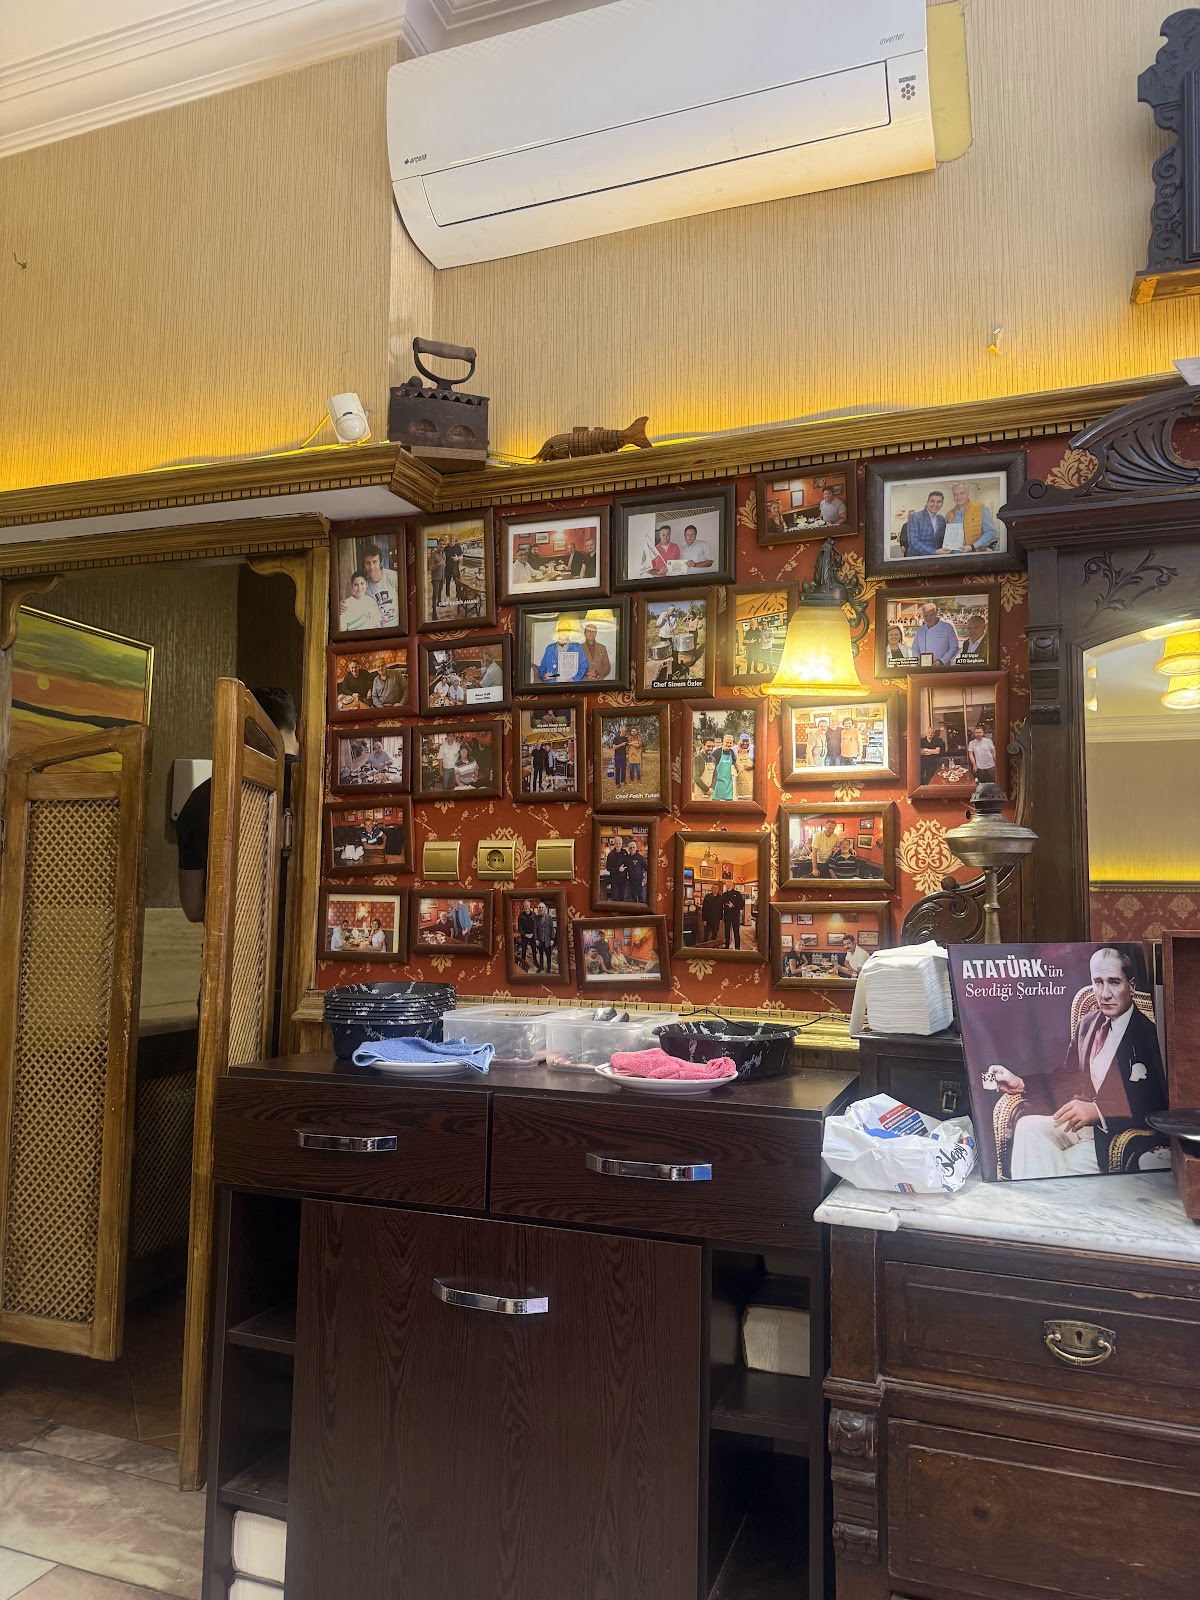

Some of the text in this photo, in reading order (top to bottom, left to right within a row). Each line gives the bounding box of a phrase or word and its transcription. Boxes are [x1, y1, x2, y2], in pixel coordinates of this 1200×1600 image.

[879, 32, 906, 46] inverter
[667, 680, 687, 688] Sinem
[687, 679, 703, 687] Özler
[965, 981, 1067, 1001] Sevdiği Şarkılar
